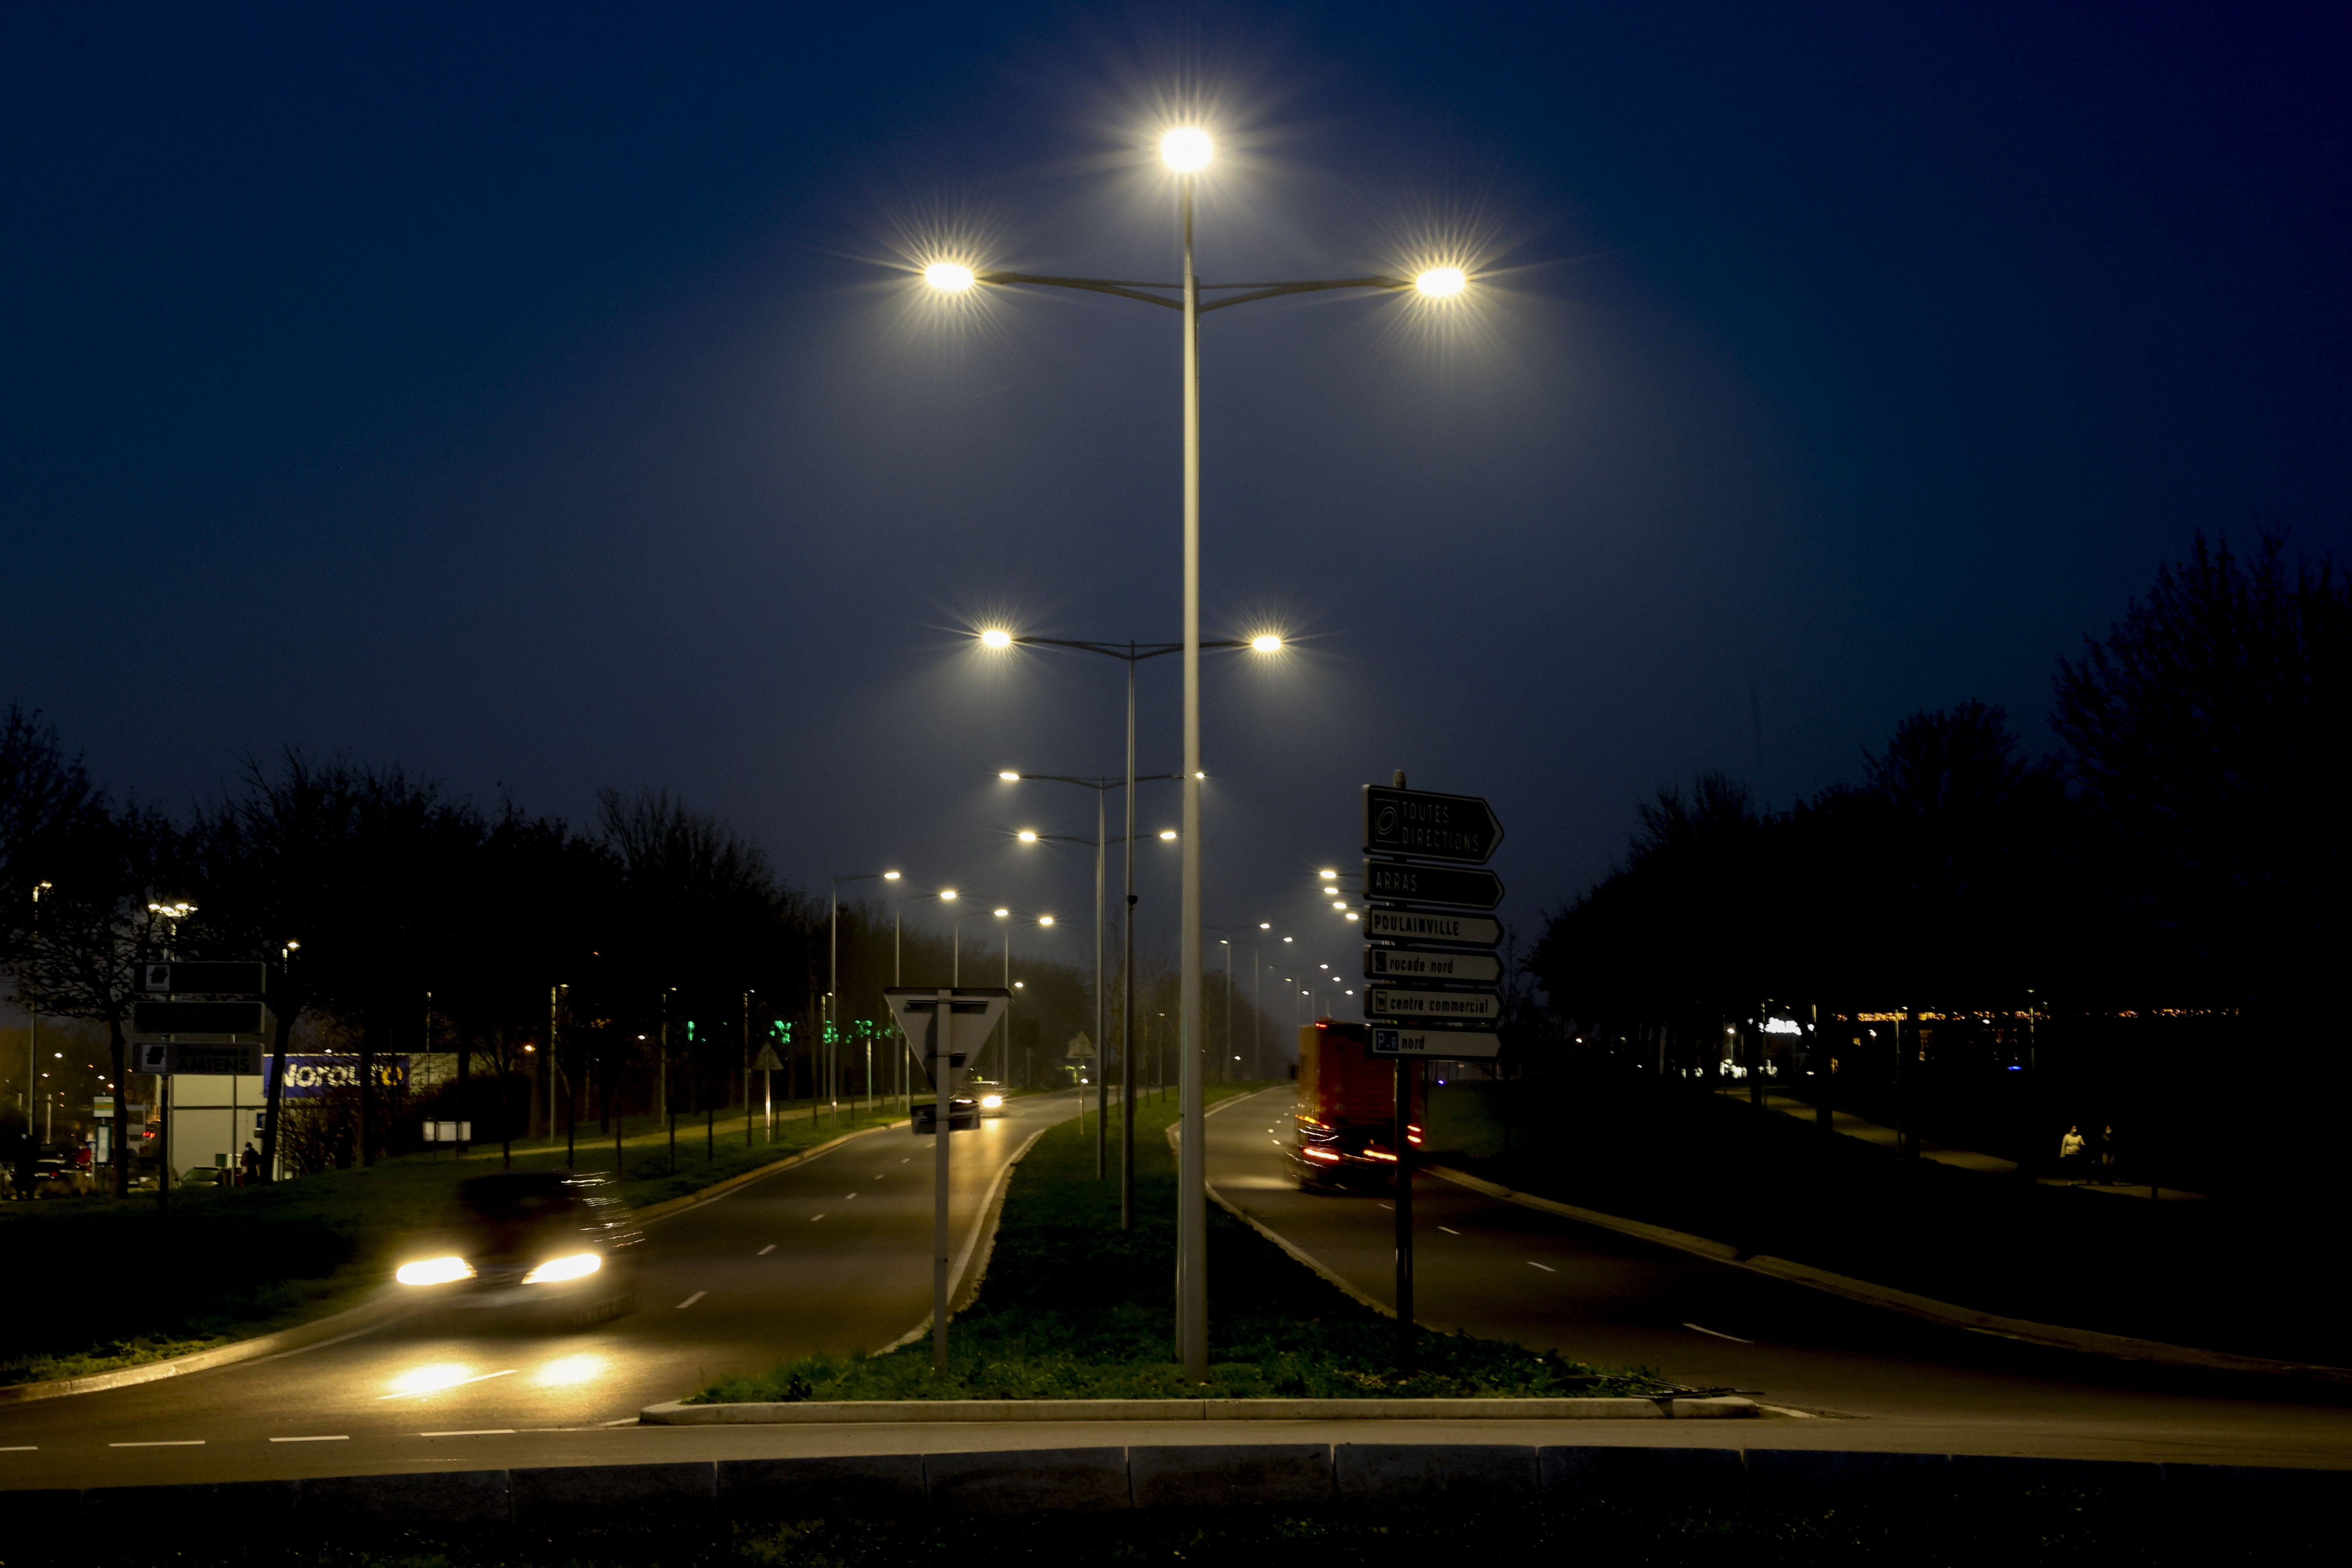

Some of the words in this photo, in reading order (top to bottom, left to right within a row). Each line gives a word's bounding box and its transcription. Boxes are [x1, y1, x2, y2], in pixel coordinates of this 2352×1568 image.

[1402, 801, 1449, 824] TOUTES
[1403, 827, 1479, 852] DIRECTIONS
[1375, 871, 1417, 892] ARRAS
[1374, 914, 1459, 936] POULAINVILLE
[1390, 957, 1425, 972] rocade
[1431, 959, 1453, 973] nord
[1390, 998, 1424, 1011] centre
[1430, 999, 1488, 1013] commercial
[1402, 1035, 1424, 1050] nord
[177, 1057, 249, 1072] AMIENS
